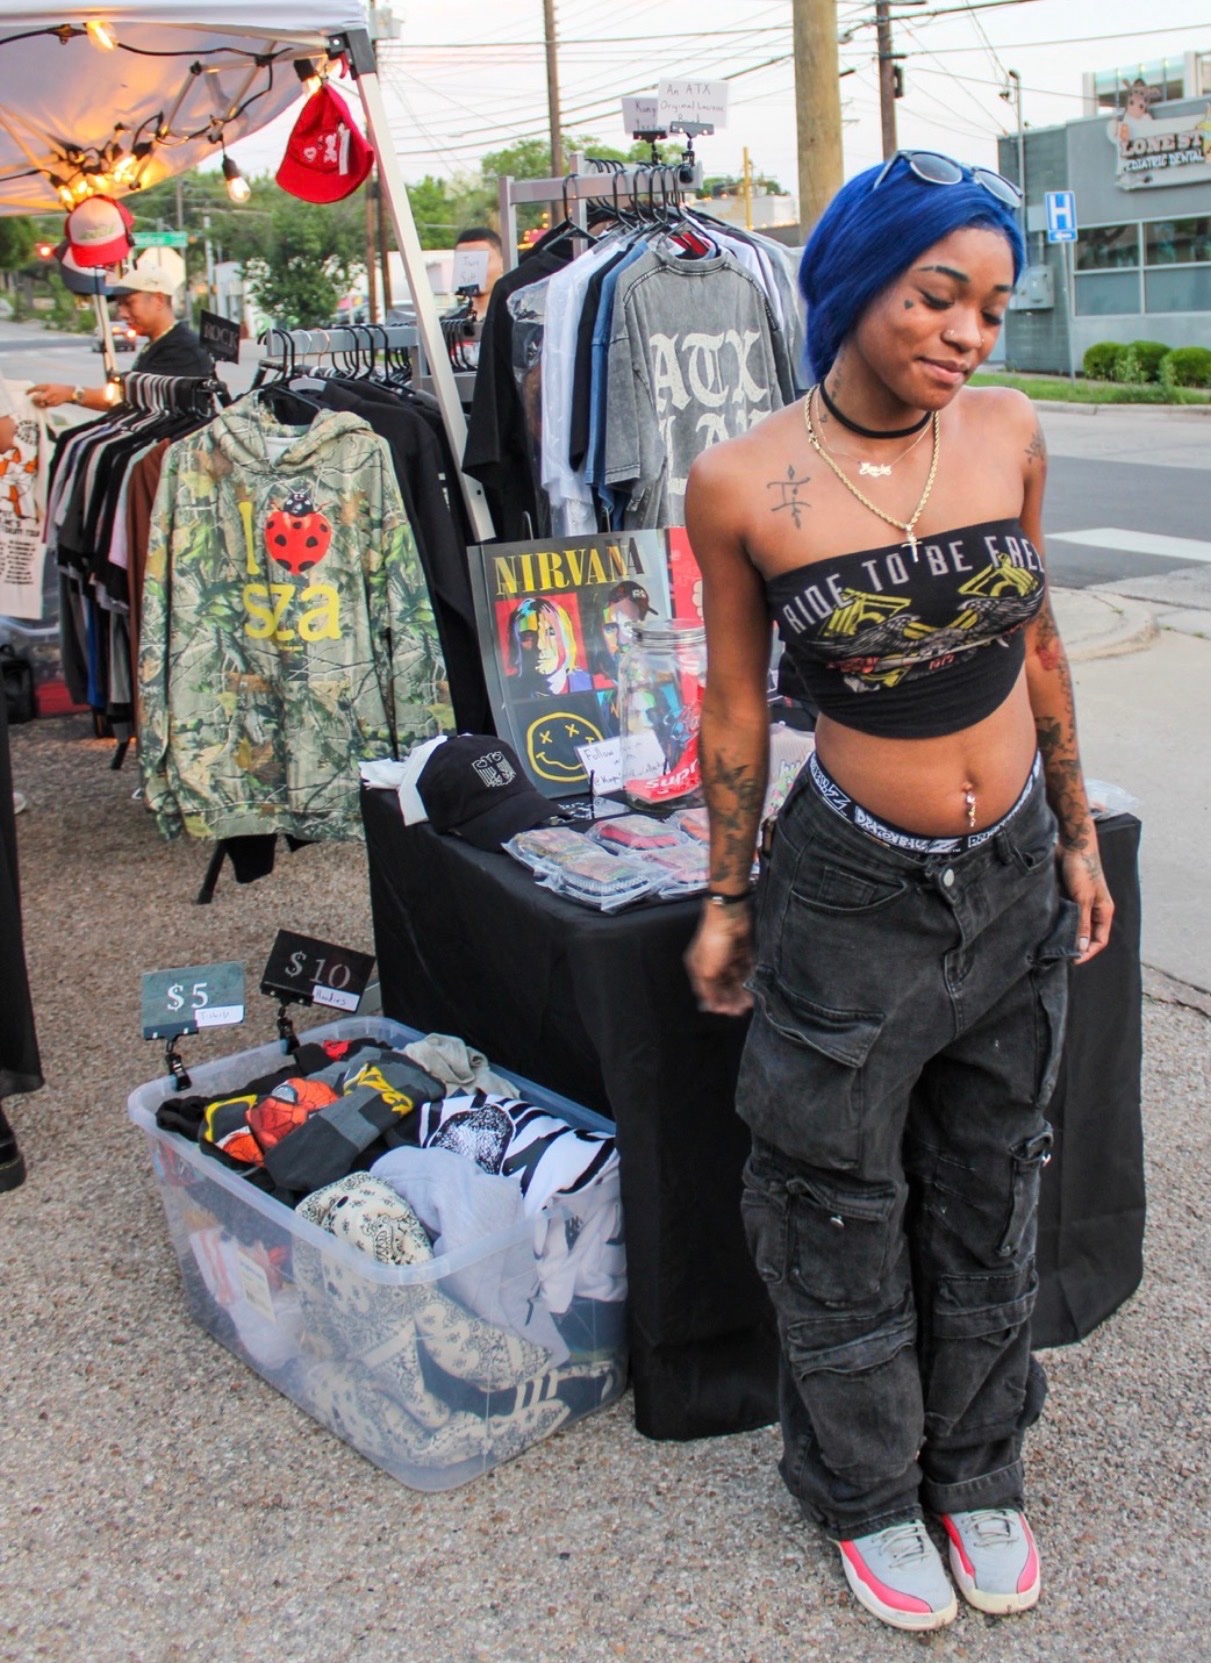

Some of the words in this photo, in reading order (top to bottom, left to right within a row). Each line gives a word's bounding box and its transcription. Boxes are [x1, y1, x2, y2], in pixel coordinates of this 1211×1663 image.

[685, 83, 712, 95] ATX
[1120, 136, 1176, 158] LONE
[1177, 130, 1204, 150] ST
[1121, 153, 1169, 173] PEDIATRIC
[1169, 149, 1205, 166] DENTAL
[1050, 194, 1073, 230] H
[649, 329, 768, 411] ATX
[491, 536, 646, 596] NIRVANA
[783, 573, 854, 634] RIDE
[861, 552, 910, 592] TO
[925, 541, 973, 577] BE
[584, 748, 615, 761] Follow
[284, 950, 351, 989] $10
[167, 982, 209, 1012] $5
